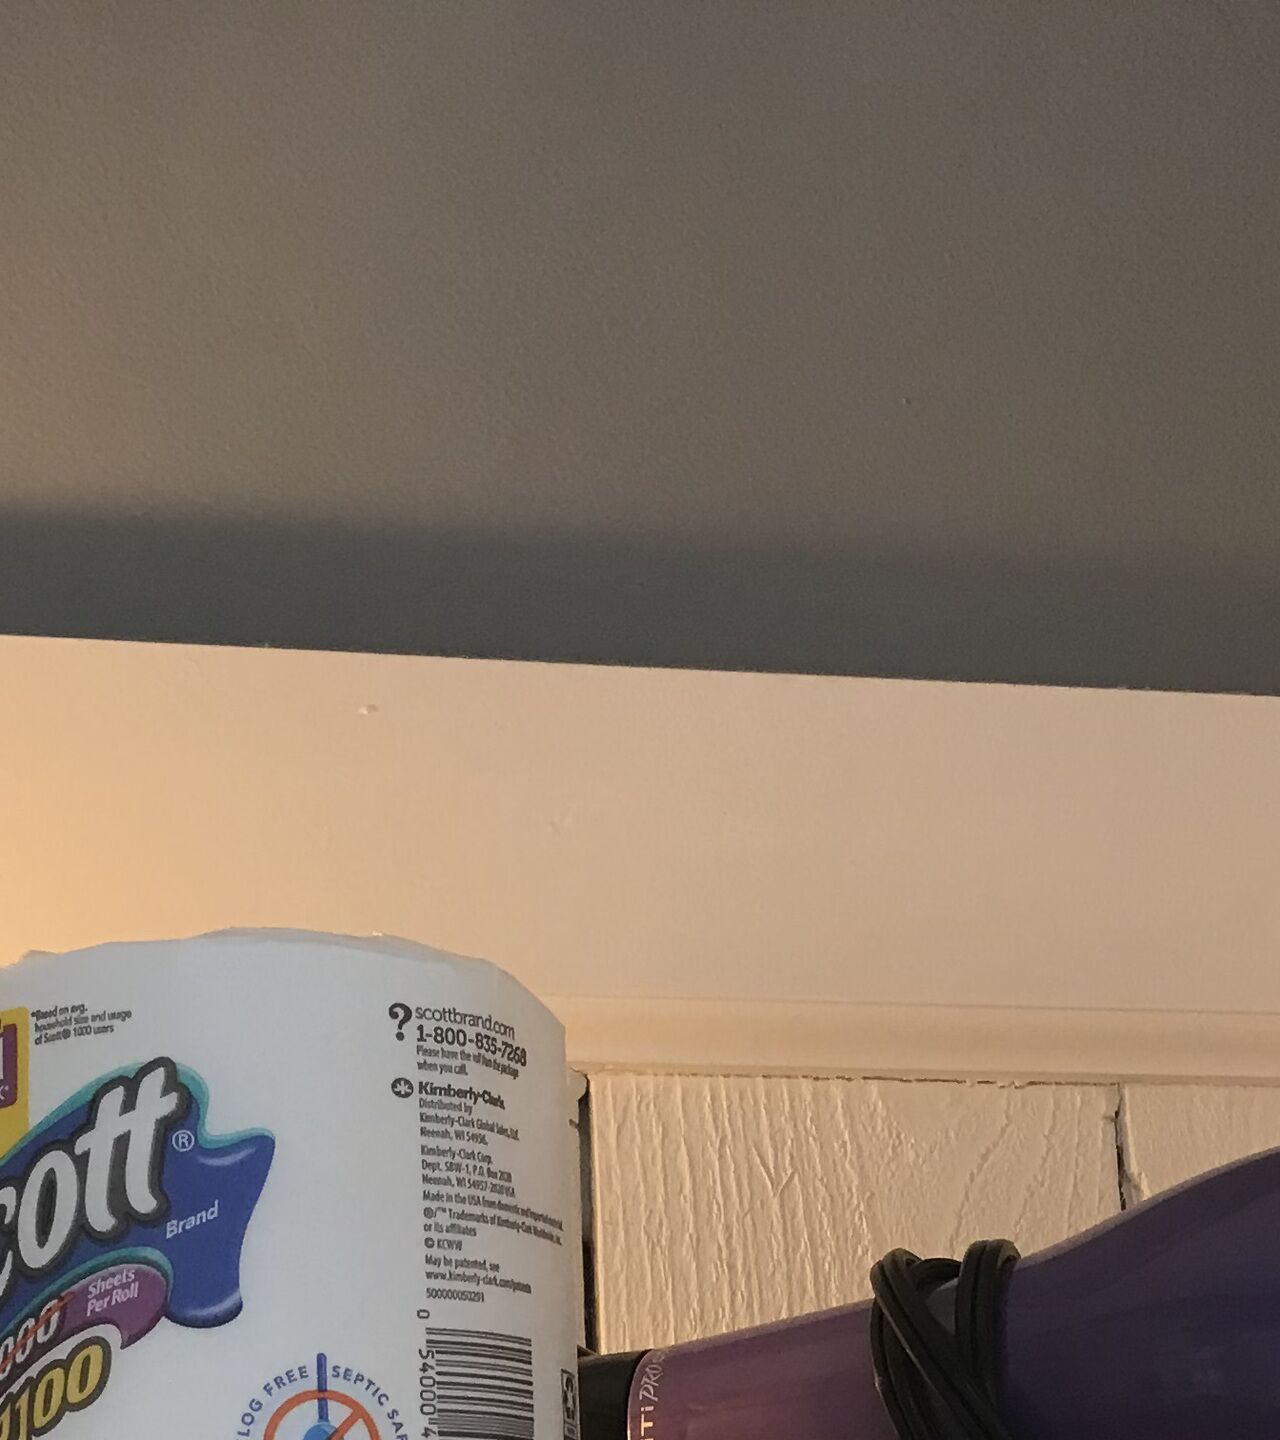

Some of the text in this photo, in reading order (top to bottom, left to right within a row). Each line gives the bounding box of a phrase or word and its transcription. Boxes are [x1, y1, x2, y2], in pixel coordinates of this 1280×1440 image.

[415, 1007, 516, 1040] scottbrand.com
[416, 1024, 527, 1067] 1-800-835-7268
[422, 1190, 445, 1202] Made
[165, 1200, 220, 1239] Brand
[86, 1281, 139, 1317] Per Roll
[87, 1268, 136, 1299] Sheets
[263, 1365, 309, 1396] FREE
[331, 1365, 389, 1407] SEPTIC
